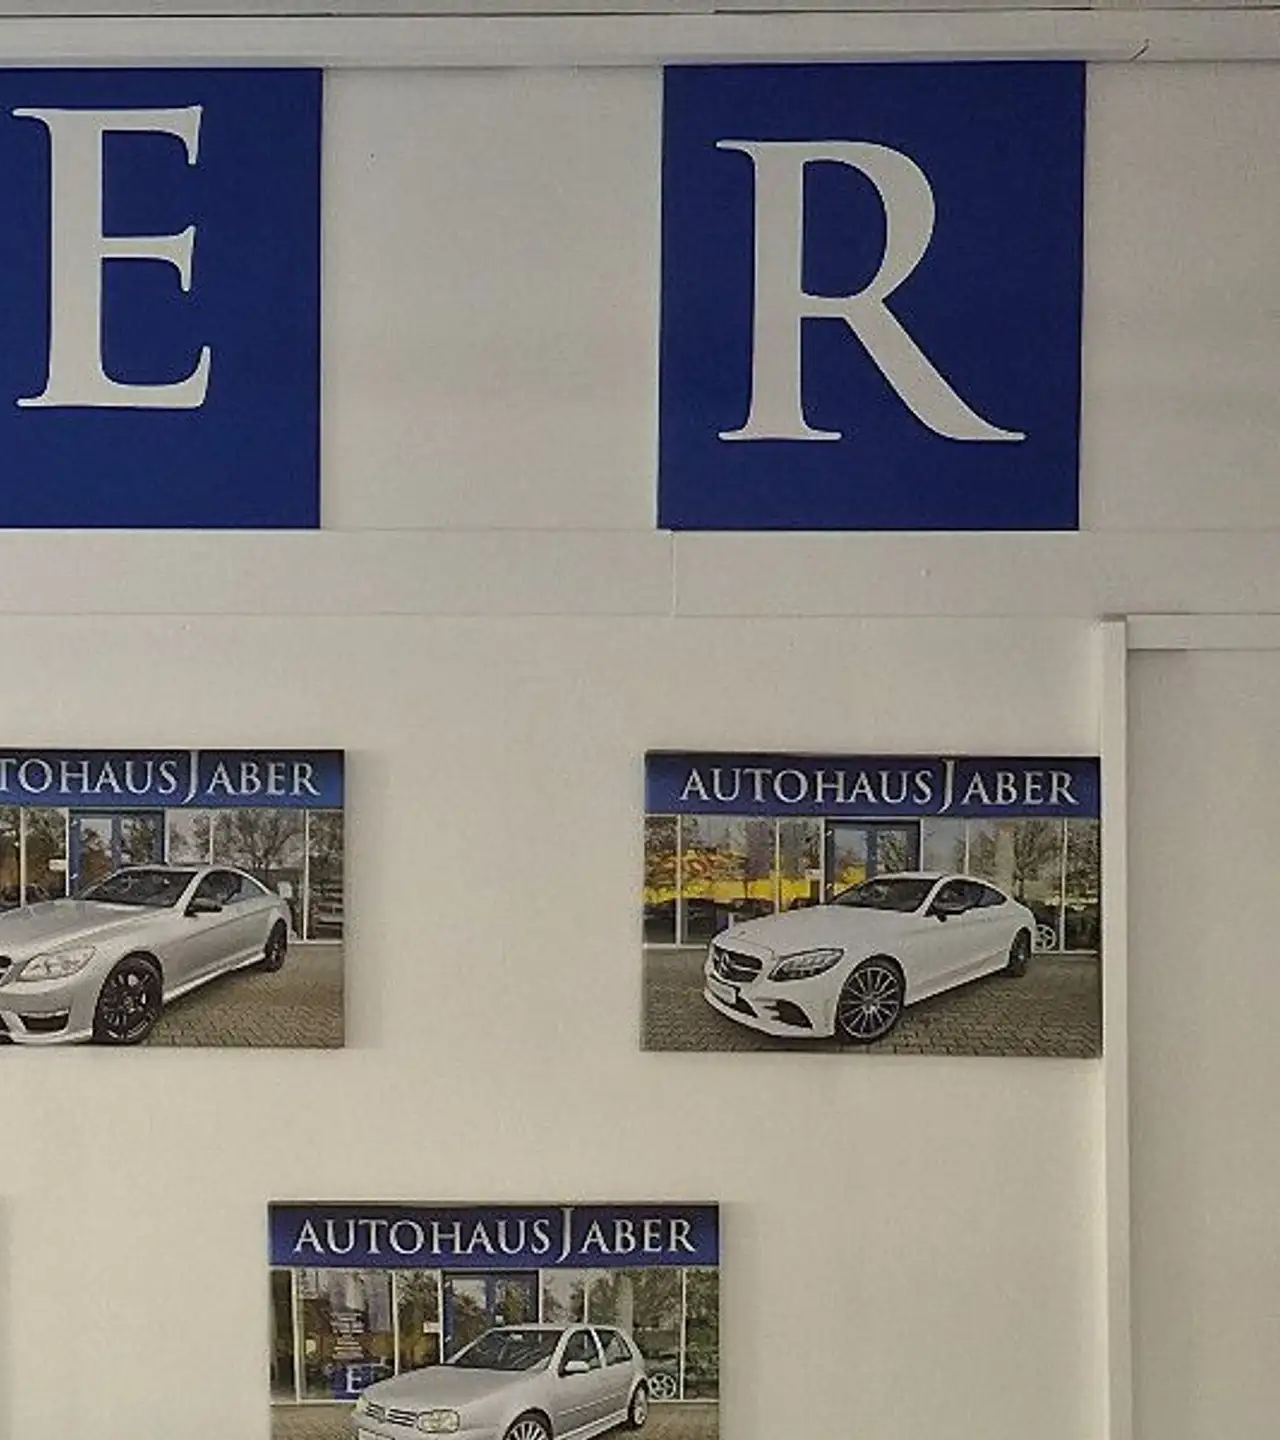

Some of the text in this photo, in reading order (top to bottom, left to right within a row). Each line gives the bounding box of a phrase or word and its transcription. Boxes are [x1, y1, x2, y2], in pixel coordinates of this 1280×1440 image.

[181, 750, 321, 804] JABER
[679, 759, 1080, 814] AUTOHAUS JABER
[292, 1207, 696, 1263] AUTOHAUS JABER
